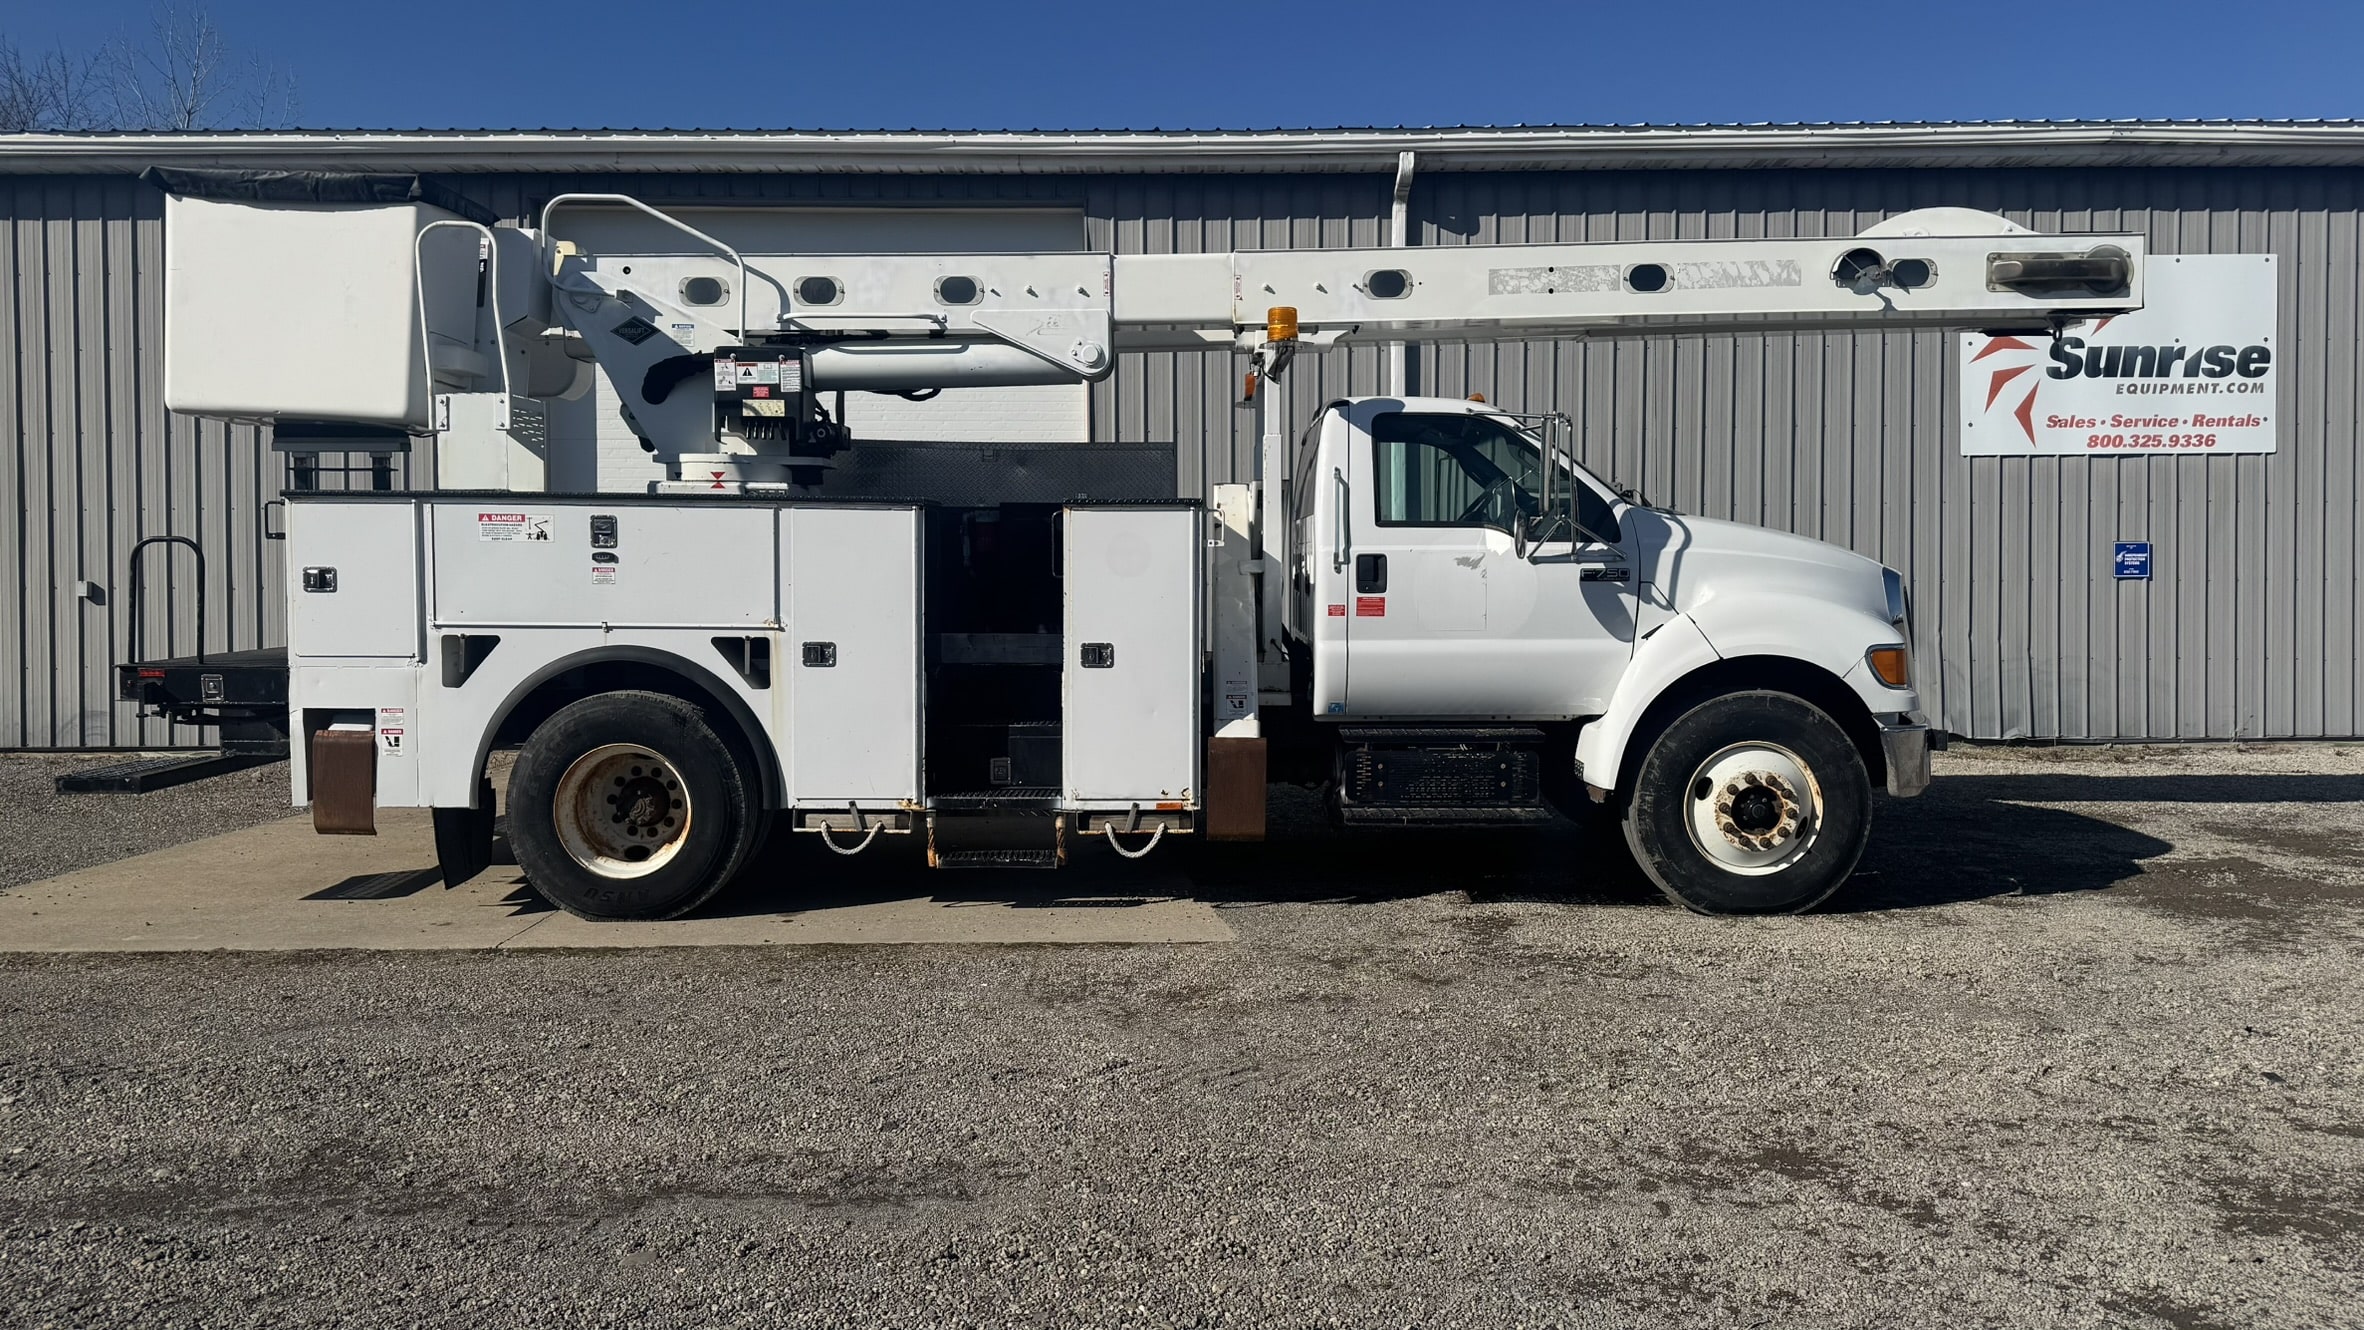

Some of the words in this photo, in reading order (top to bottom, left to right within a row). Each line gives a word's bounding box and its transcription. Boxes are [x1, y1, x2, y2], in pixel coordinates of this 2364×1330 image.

[2045, 336, 2271, 380] Sunrise
[2115, 382, 2265, 395] EQUIPMENT.COM
[2046, 414, 2096, 428] Sales
[2110, 415, 2179, 428] Service
[2191, 414, 2261, 428] Rentals
[2086, 434, 2216, 448] 800.325.9336
